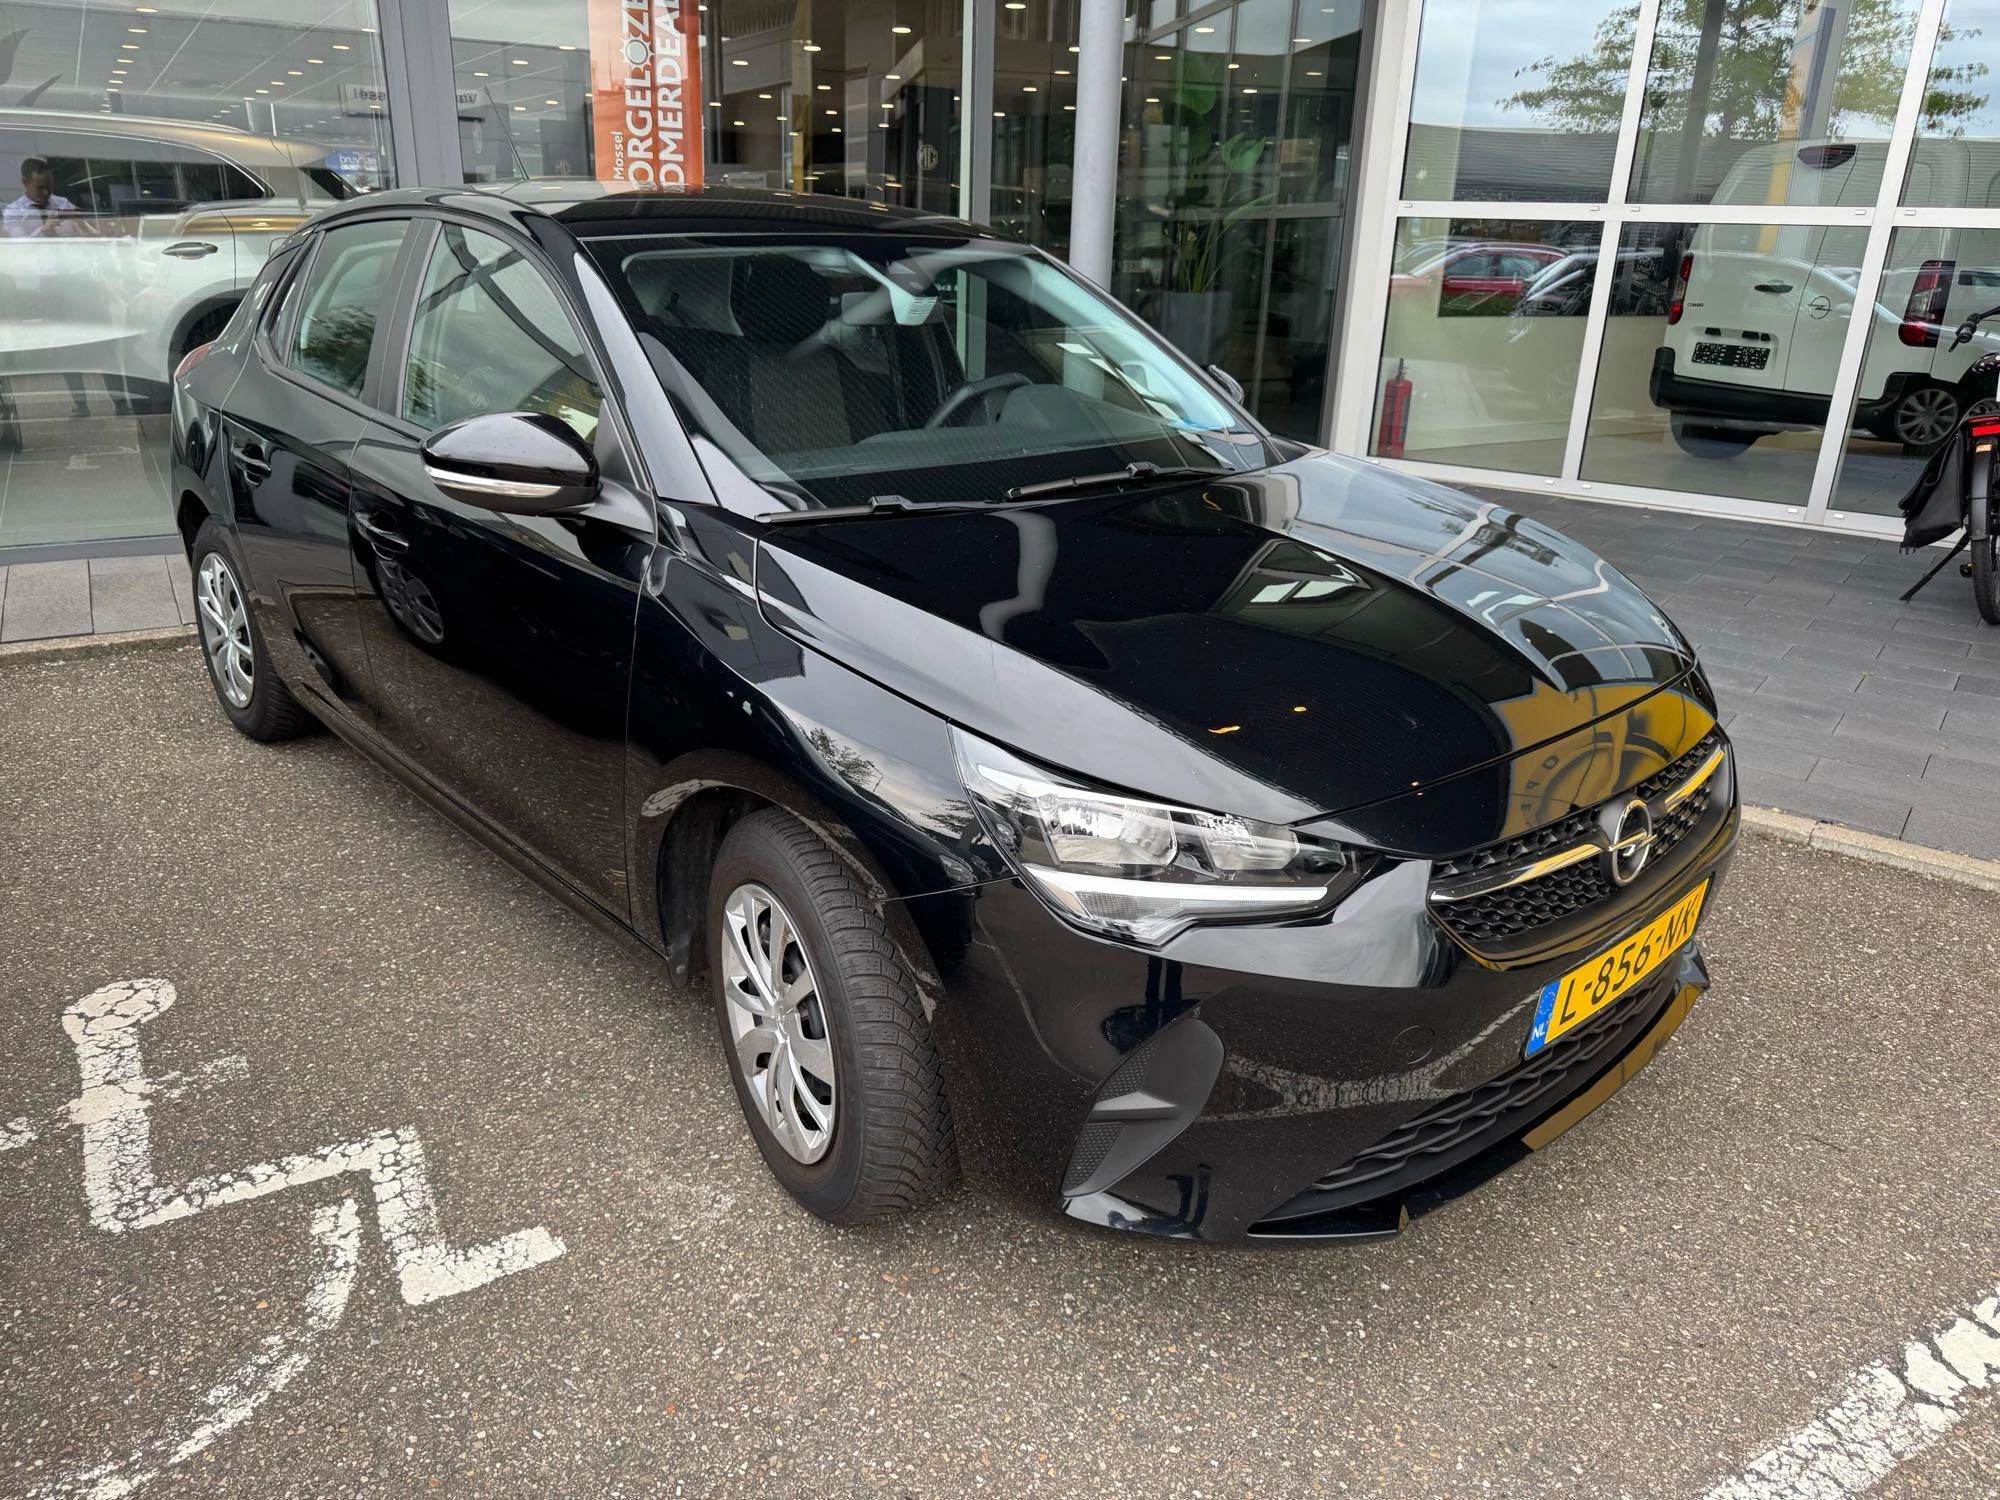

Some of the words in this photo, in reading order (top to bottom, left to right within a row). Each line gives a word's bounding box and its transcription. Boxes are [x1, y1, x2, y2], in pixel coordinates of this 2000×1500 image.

[611, 131, 625, 180] Mossel
[1531, 1022, 1546, 1040] NL
[1559, 893, 1700, 1026] L-856-NK
